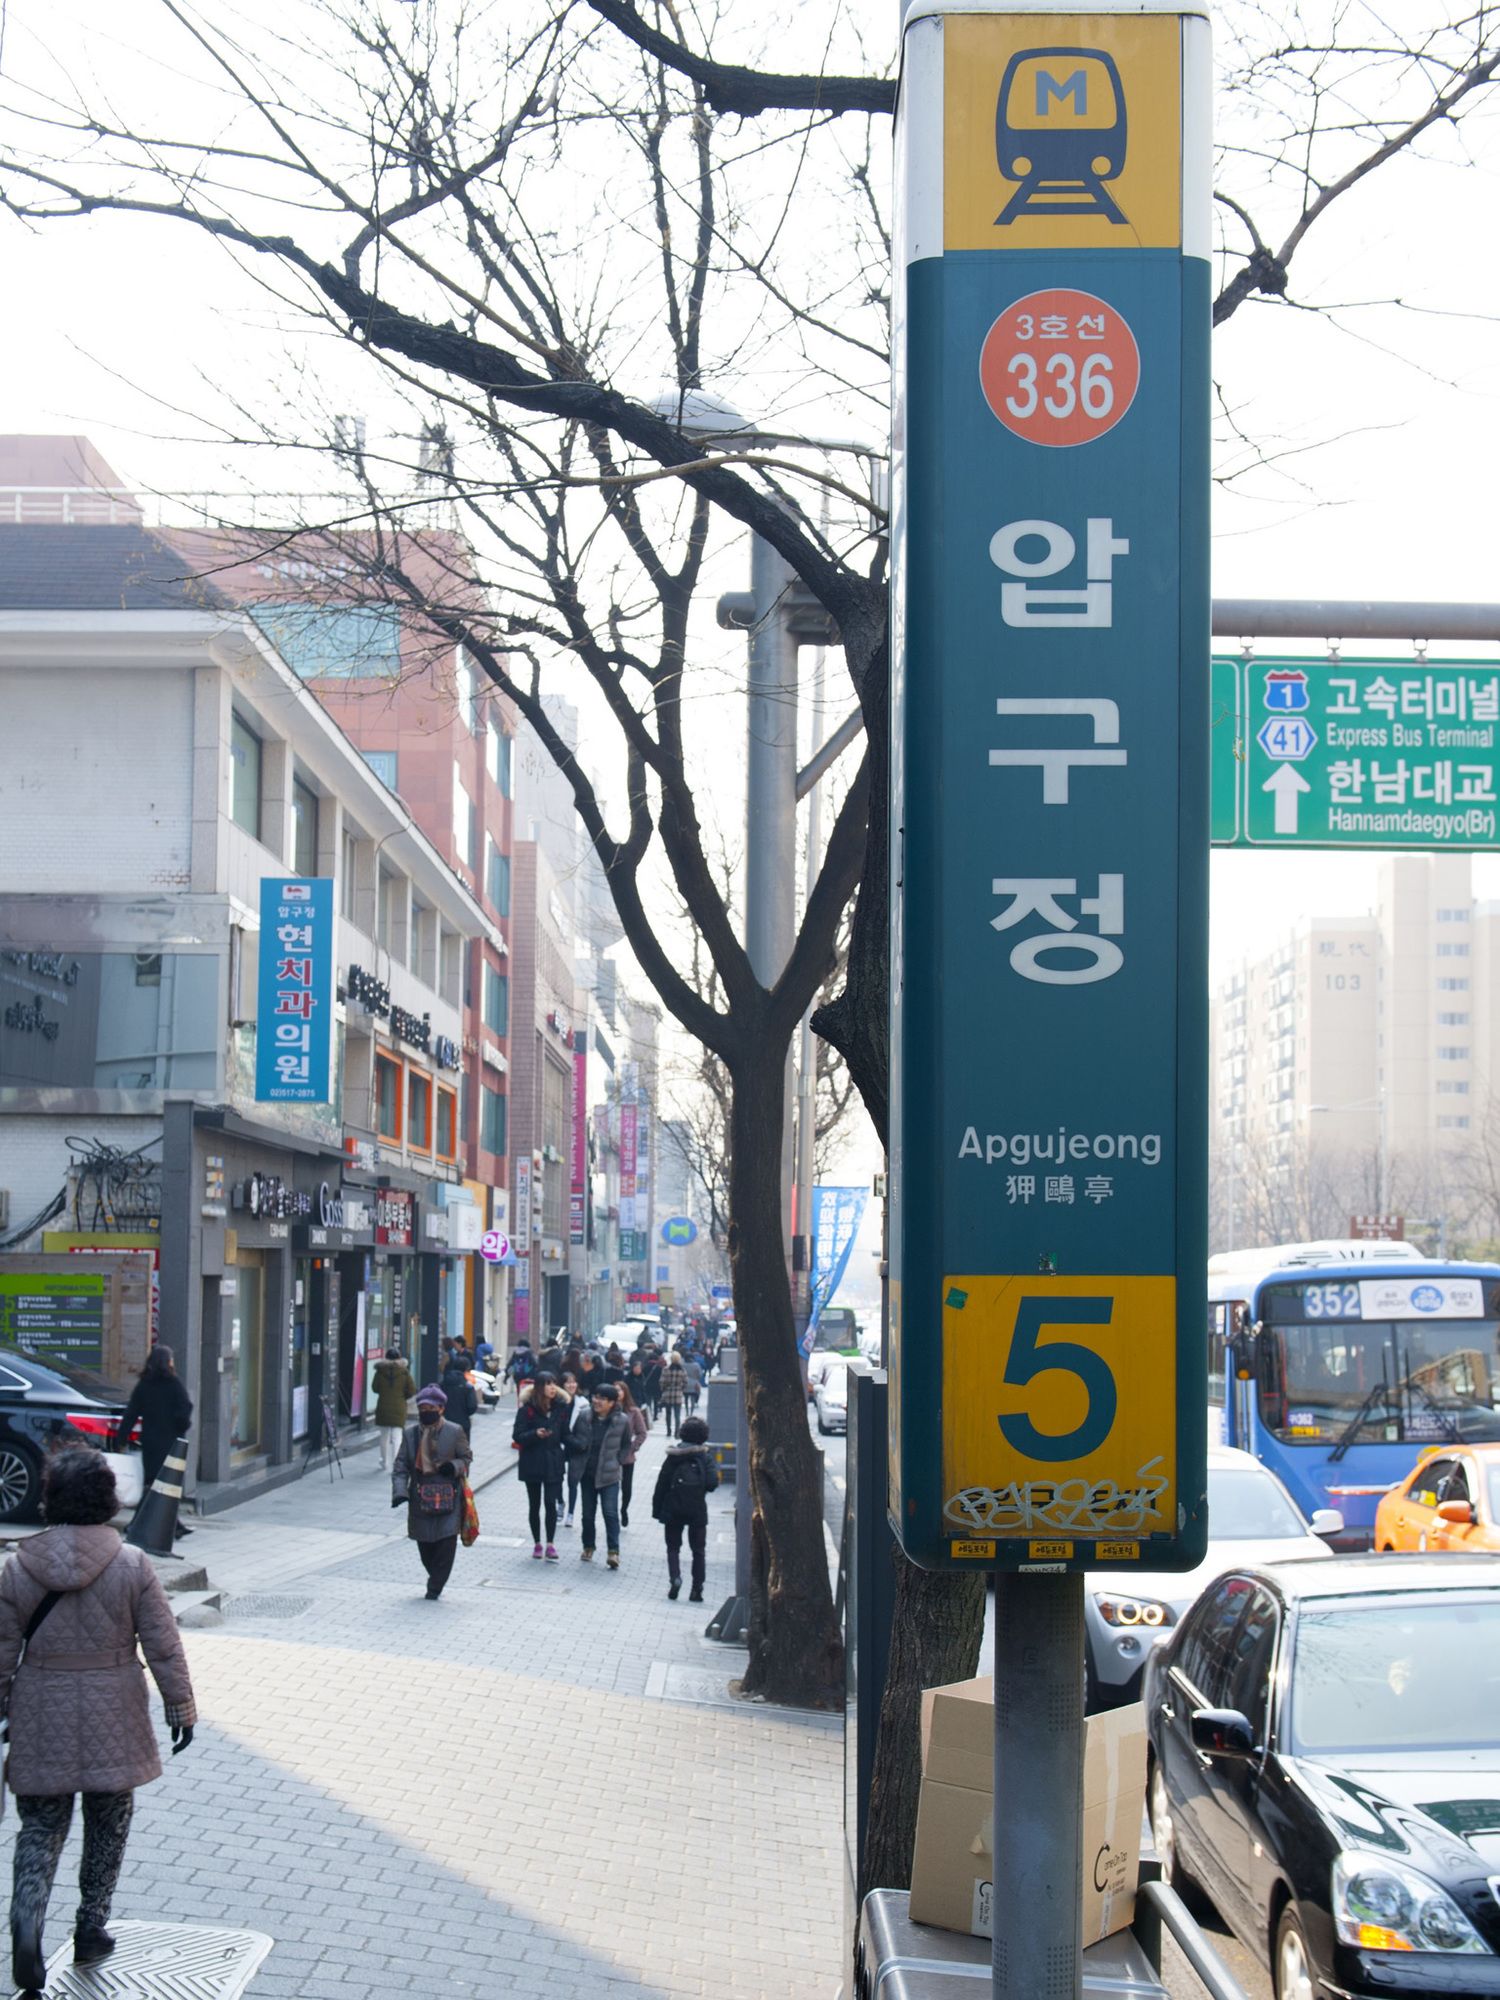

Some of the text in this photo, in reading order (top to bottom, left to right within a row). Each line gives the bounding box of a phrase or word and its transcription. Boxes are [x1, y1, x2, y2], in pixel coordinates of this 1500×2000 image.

[1035, 70, 1087, 116] M
[1015, 313, 1105, 341] 3호선
[1005, 352, 1114, 420] 336
[1281, 684, 1293, 707] 1
[1325, 675, 1499, 722] 고속터미널
[988, 517, 1130, 986] 압구정
[1272, 723, 1301, 752] 41
[1326, 722, 1494, 751] Express Bus Terminal
[1326, 758, 1497, 805] 한남대교
[277, 906, 316, 919] 압구정
[1325, 973, 1361, 991] 103
[957, 1126, 1162, 1166] Apgujeong
[1305, 1283, 1360, 1318] 352
[997, 1296, 1118, 1463] 5
